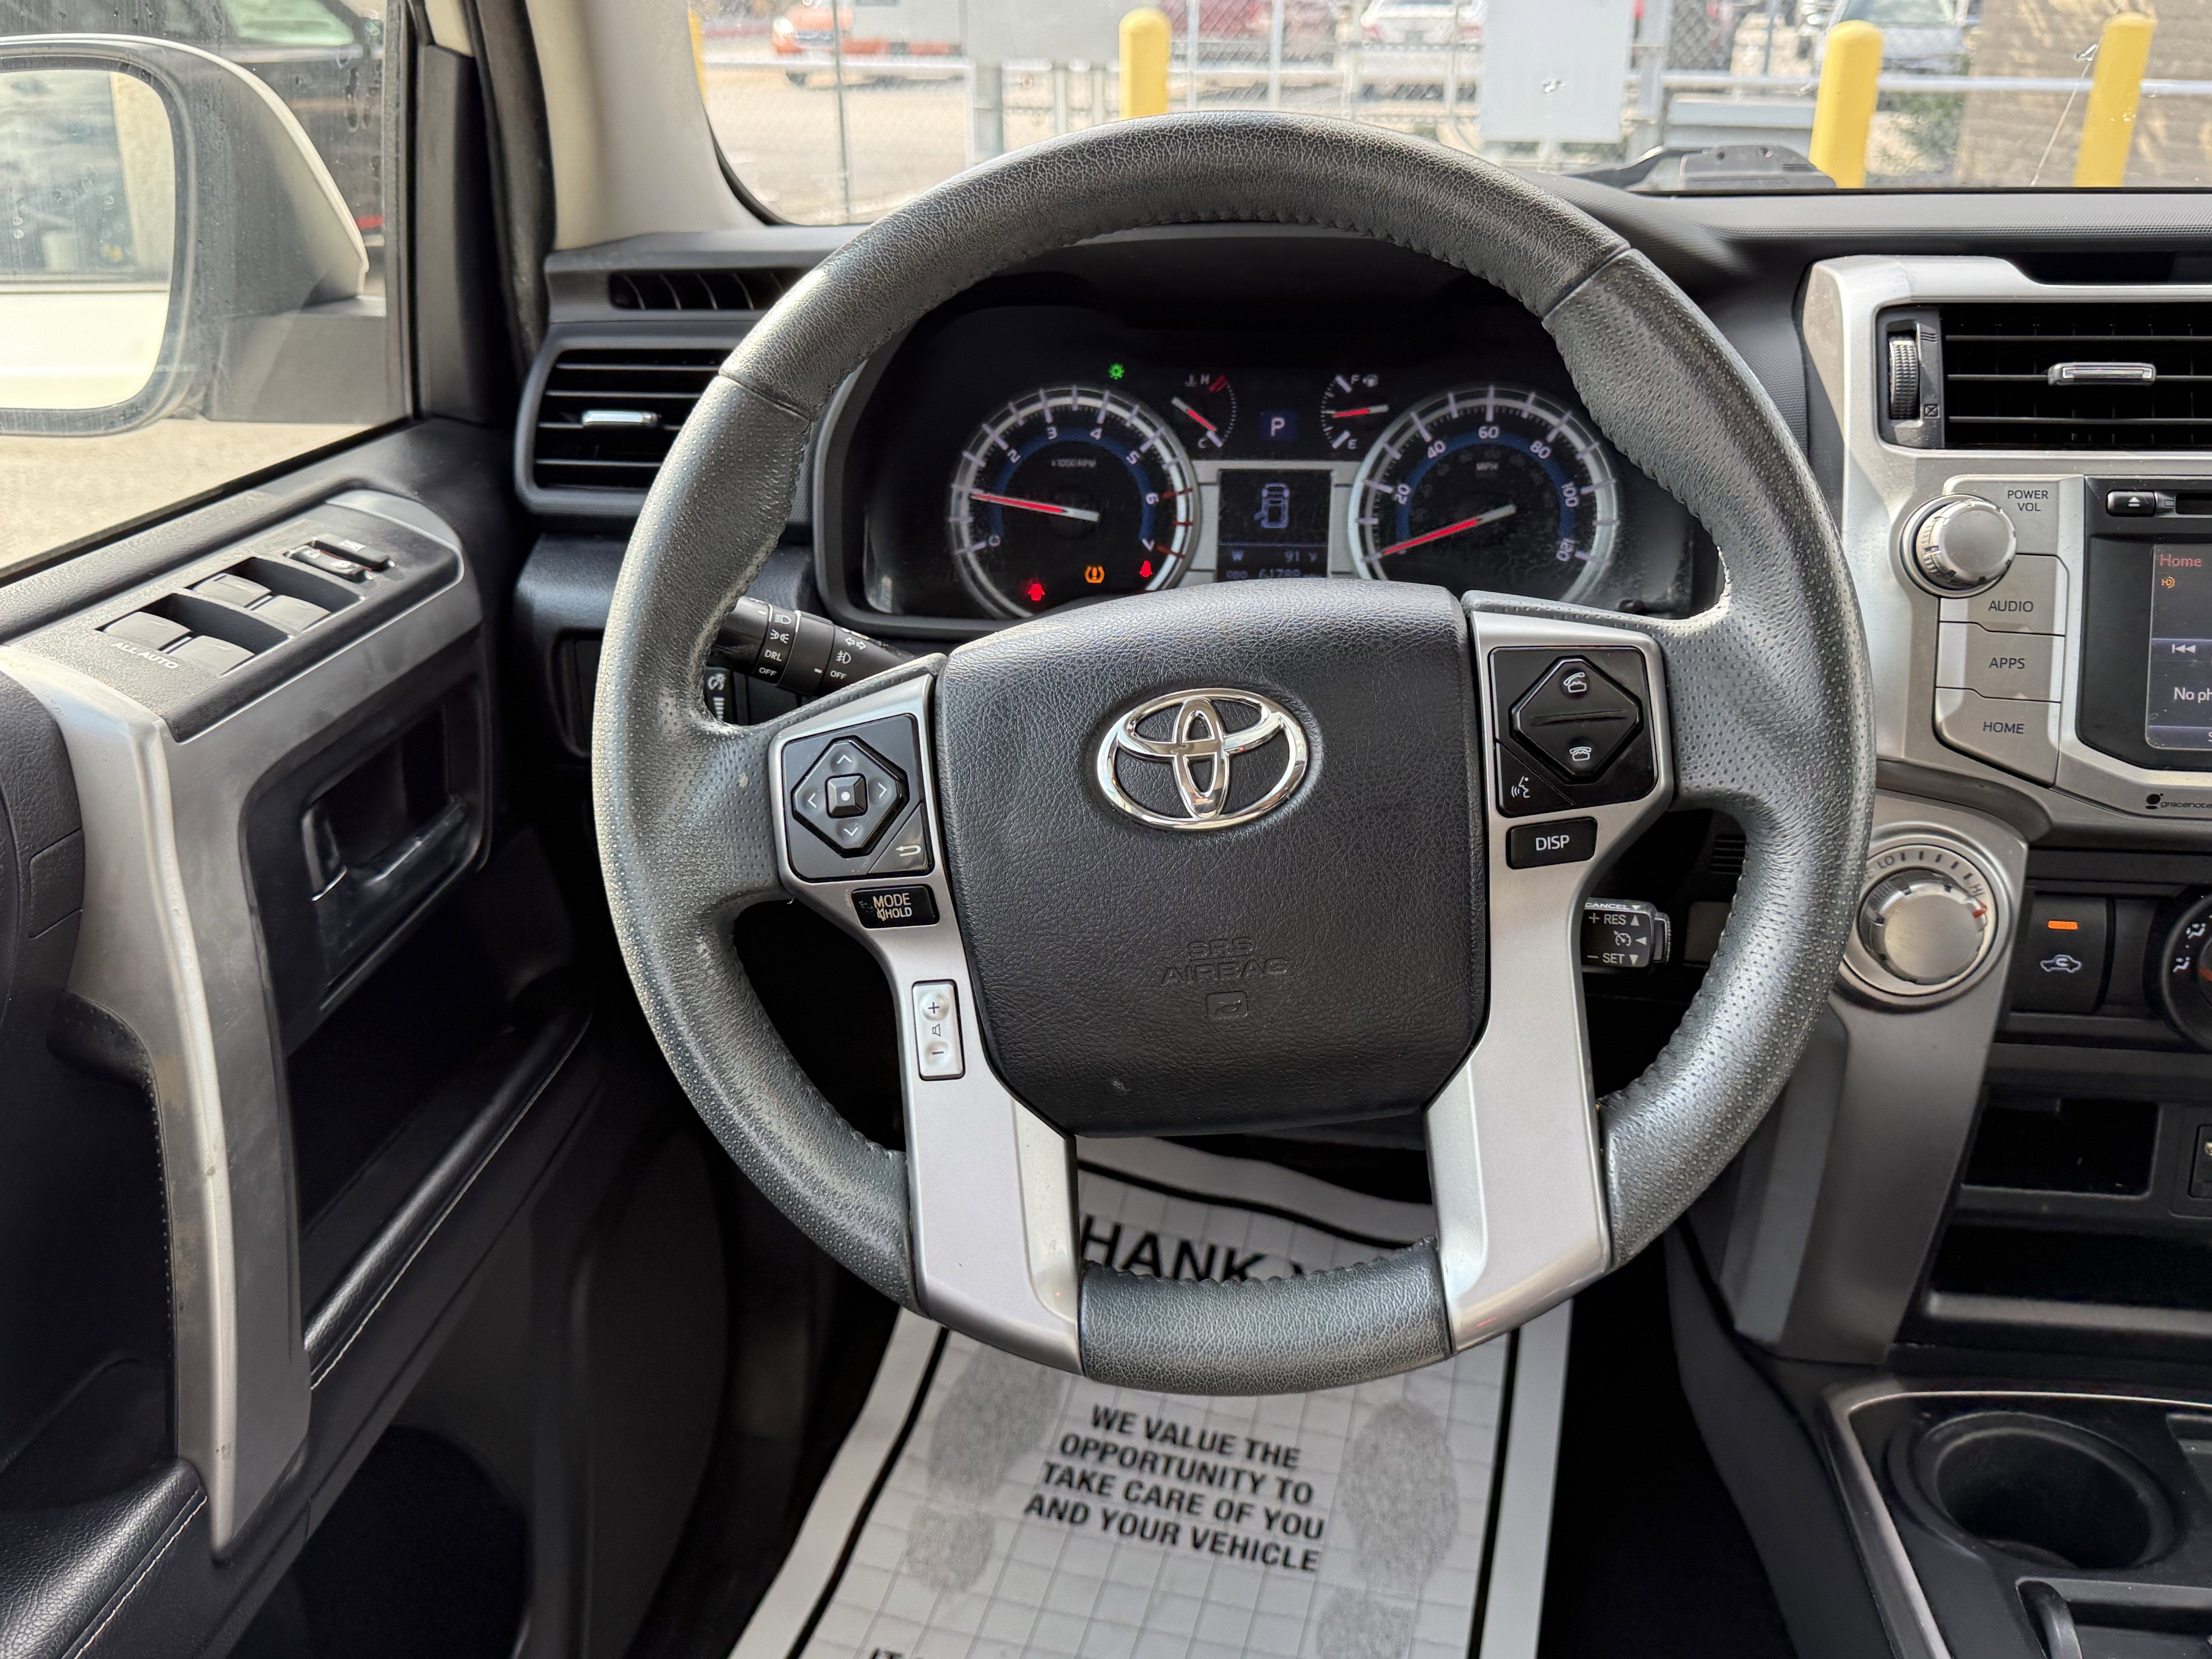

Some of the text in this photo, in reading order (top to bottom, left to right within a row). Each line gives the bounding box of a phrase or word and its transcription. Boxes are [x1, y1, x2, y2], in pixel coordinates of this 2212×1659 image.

[1351, 374, 1360, 385] F
[1047, 426, 1058, 440] 3
[1090, 428, 1103, 440] 4
[1271, 417, 1285, 437] P
[1479, 426, 1500, 439] 60
[1348, 438, 1358, 449] E
[1427, 440, 1446, 459] 40
[1530, 440, 1551, 459] 80
[1008, 448, 1022, 464] 2
[1126, 450, 1140, 465] 5
[1146, 492, 1159, 505] 6
[1394, 483, 1411, 505] 20
[1561, 483, 1579, 507] 100
[2008, 490, 2049, 500] POWER
[2017, 502, 2041, 512] VOL
[988, 534, 1001, 547] 0
[1142, 538, 1155, 551] 7
[1284, 549, 1300, 563] 91
[1556, 538, 1575, 562] 120
[2160, 554, 2202, 567] Home
[1988, 601, 2033, 612] AUDIO
[110, 642, 179, 669] ALL AUTO
[764, 649, 782, 662] DRL
[1989, 658, 2025, 669] APPS
[759, 667, 777, 676] OFF
[830, 670, 847, 679] OFF
[2174, 687, 2195, 701] No
[1983, 721, 2025, 734] HOME
[1535, 835, 1570, 851] DISP
[1877, 855, 1894, 869] LO
[873, 893, 912, 909] MODE
[886, 907, 912, 918] HOLD
[1604, 914, 1626, 925] RES
[1188, 936, 1253, 957] SRS
[1602, 953, 1625, 964] SET
[1162, 957, 1288, 984] AIRBAG
[1091, 1403, 1301, 1470] WE VALUE THE
[1060, 1433, 1314, 1505] OPPORTUNITY TO
[1043, 1461, 1325, 1540] TAKE CARE OF YOU
[1024, 1494, 1322, 1572] AND YOUR VEHICLE
